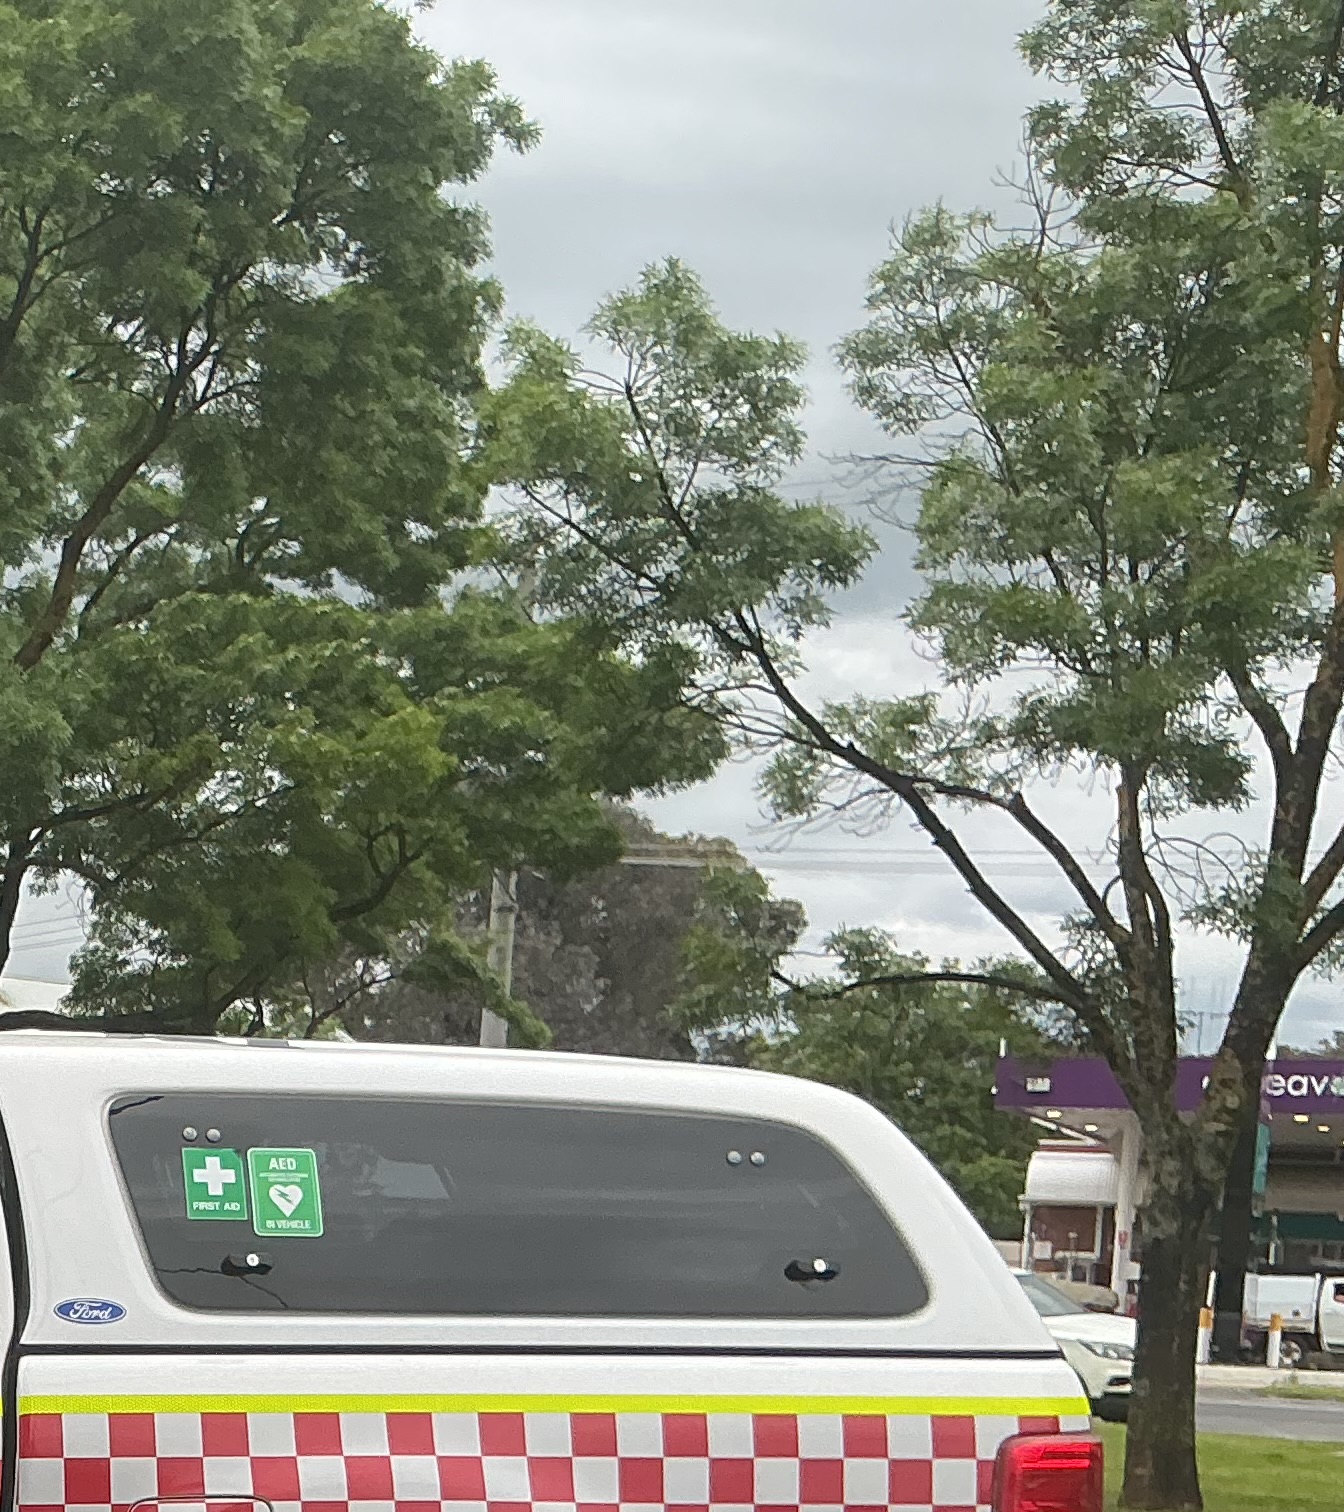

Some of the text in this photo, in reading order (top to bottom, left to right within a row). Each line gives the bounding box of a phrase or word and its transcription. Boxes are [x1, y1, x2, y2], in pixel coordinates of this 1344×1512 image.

[268, 1157, 297, 1171] AED
[192, 1201, 241, 1212] FIRST AID
[276, 1219, 312, 1230] VEHICLE
[69, 1301, 113, 1320] Ford
